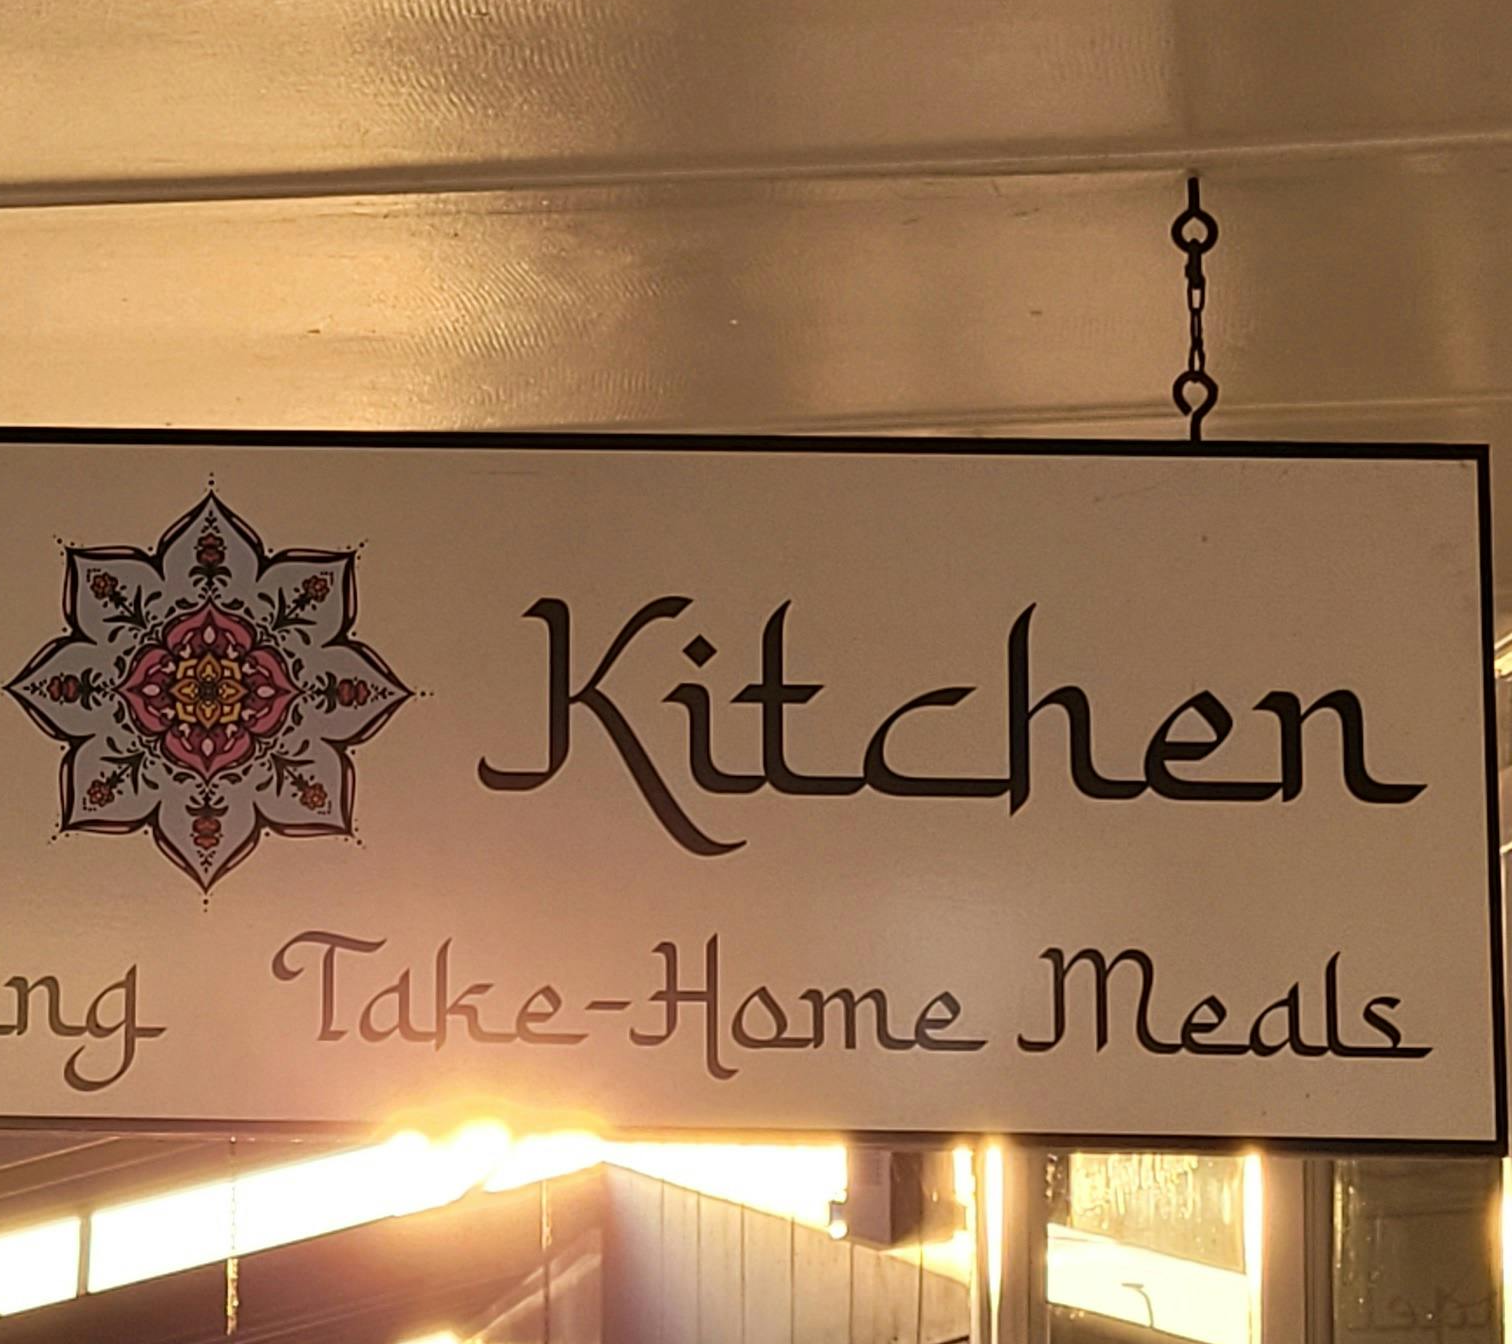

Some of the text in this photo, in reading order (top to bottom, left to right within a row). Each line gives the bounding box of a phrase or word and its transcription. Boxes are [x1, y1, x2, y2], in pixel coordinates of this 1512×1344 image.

[477, 596, 1430, 857] Kitchen
[272, 929, 988, 1082] Take-Home
[1019, 945, 1433, 1060] Meals
